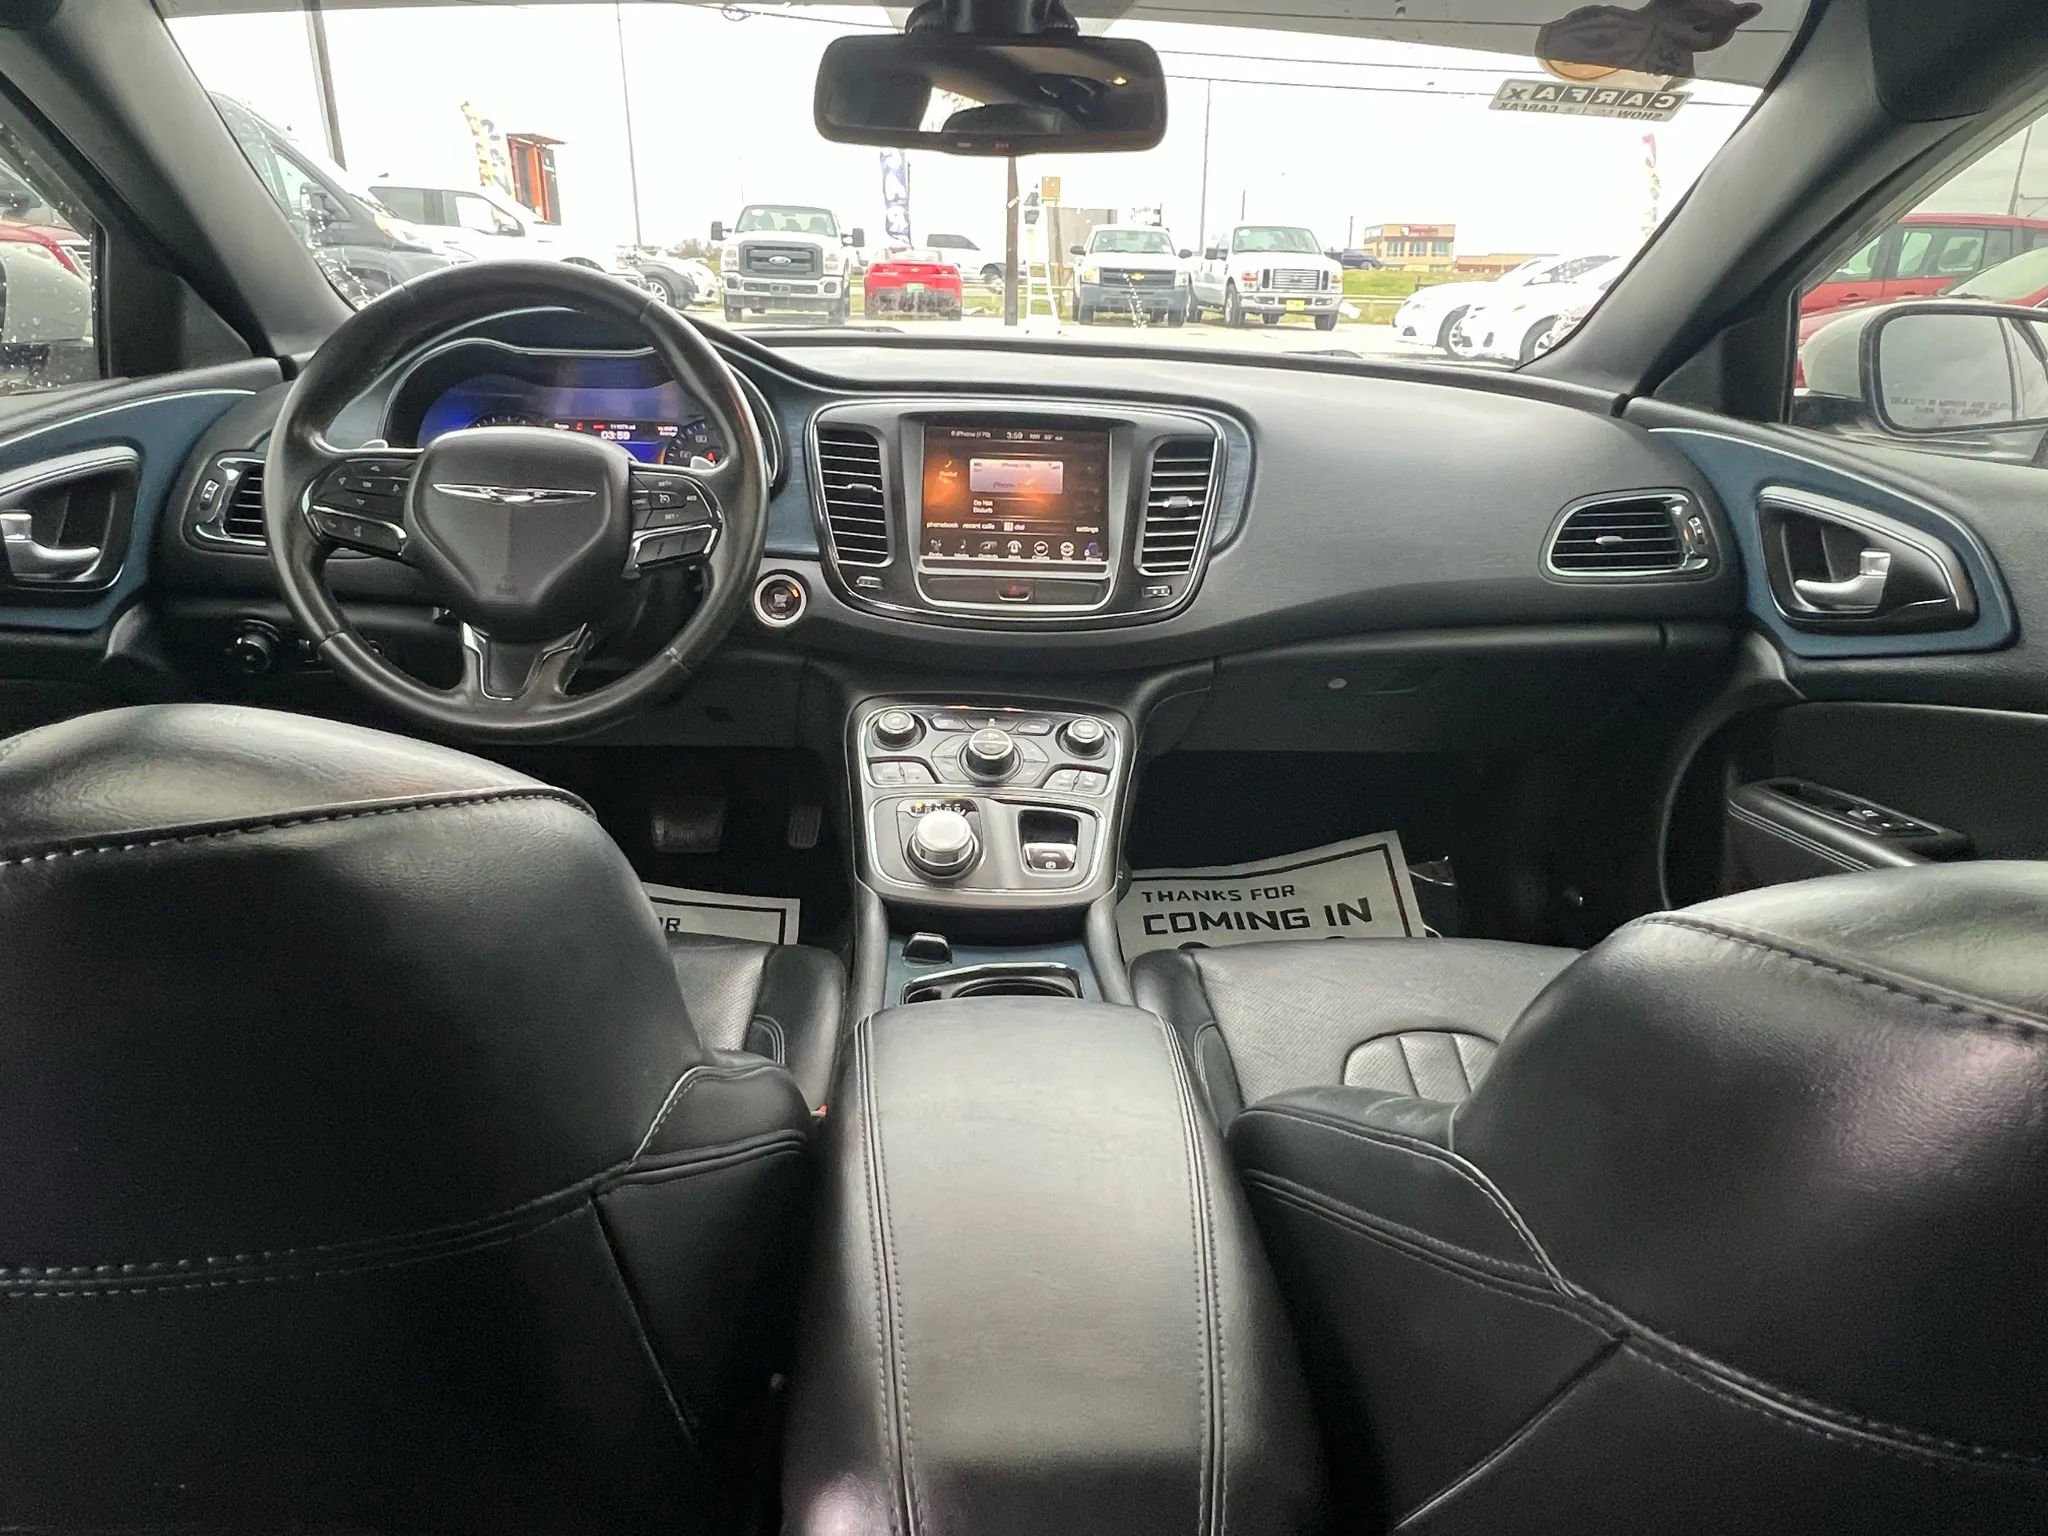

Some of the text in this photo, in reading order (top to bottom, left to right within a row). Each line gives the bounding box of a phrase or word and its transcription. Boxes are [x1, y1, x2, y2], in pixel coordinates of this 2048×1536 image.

[600, 430, 631, 440] 03:59
[1076, 525, 1099, 534] settings
[1141, 884, 1296, 903] THANKS FOR
[1142, 897, 1373, 936] COMING IN
